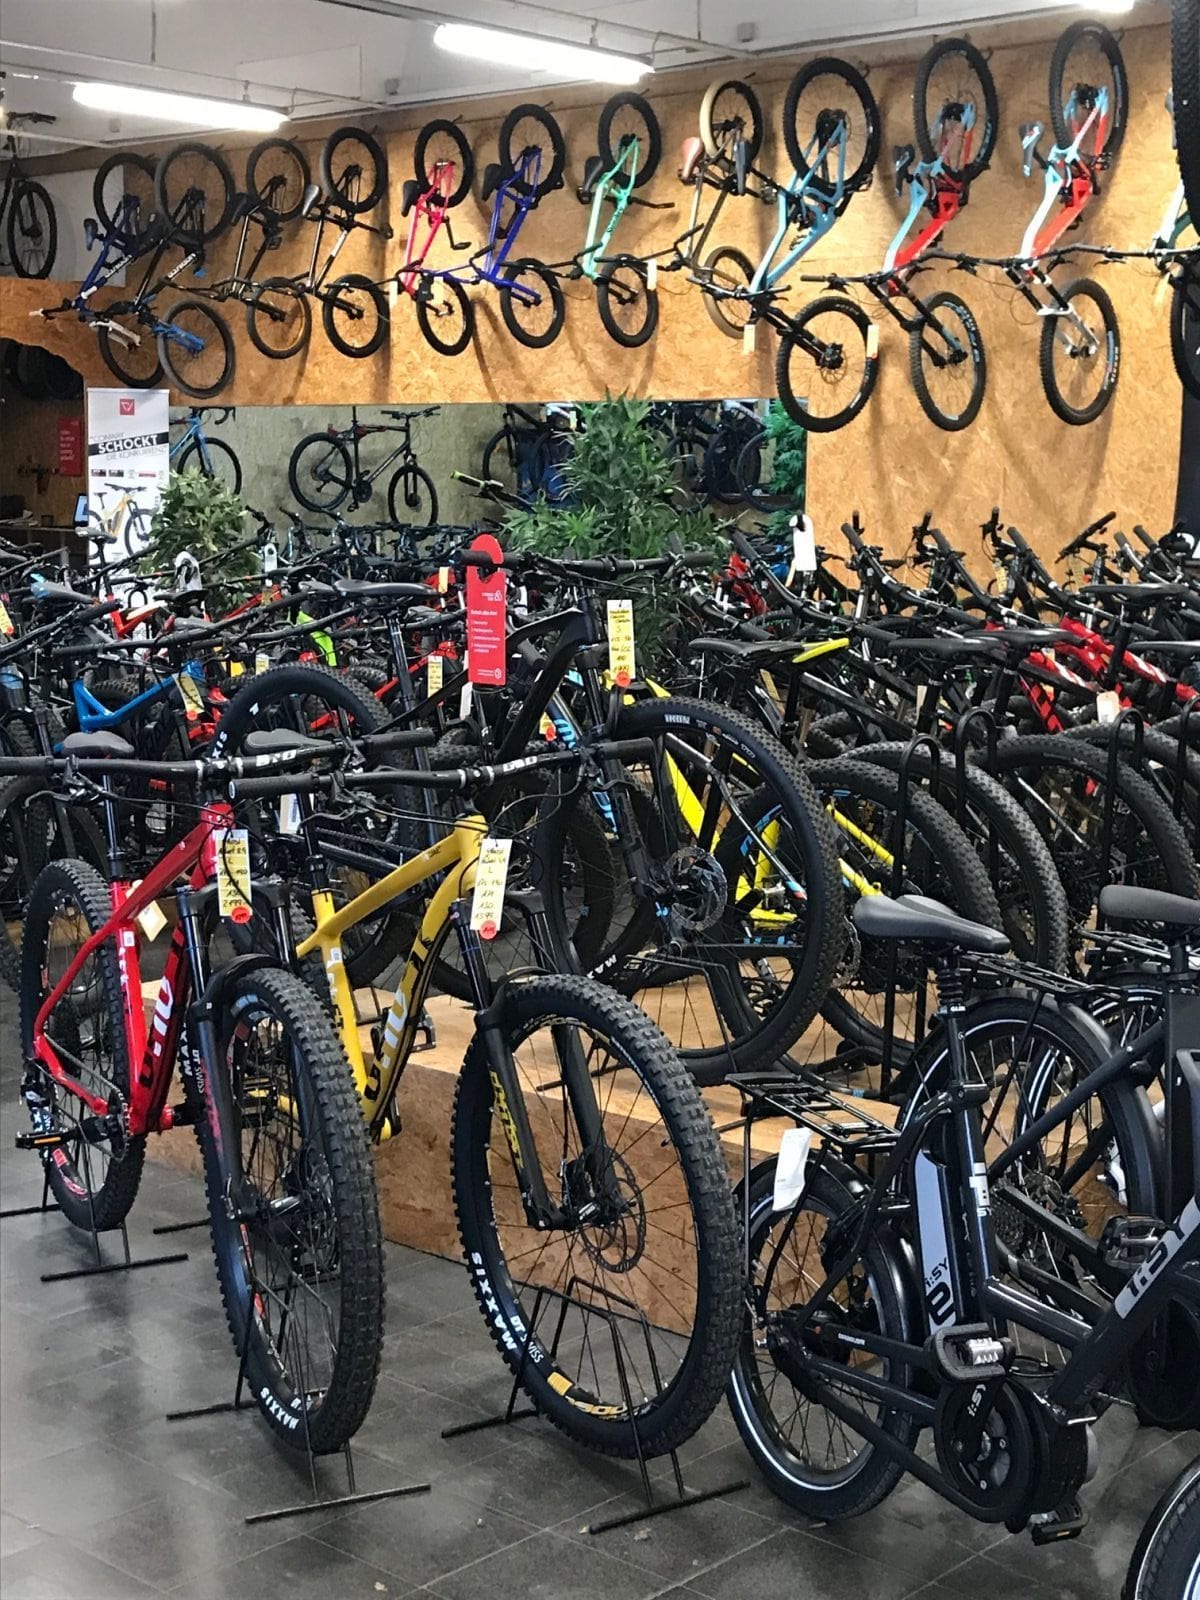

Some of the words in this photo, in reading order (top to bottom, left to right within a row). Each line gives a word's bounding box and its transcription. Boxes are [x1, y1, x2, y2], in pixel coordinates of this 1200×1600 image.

[98, 435, 158, 454] SCHOCKT
[471, 1251, 518, 1350] MAXXIS
[510, 1315, 526, 1333] DT
[260, 1387, 300, 1430] MAXXIS
